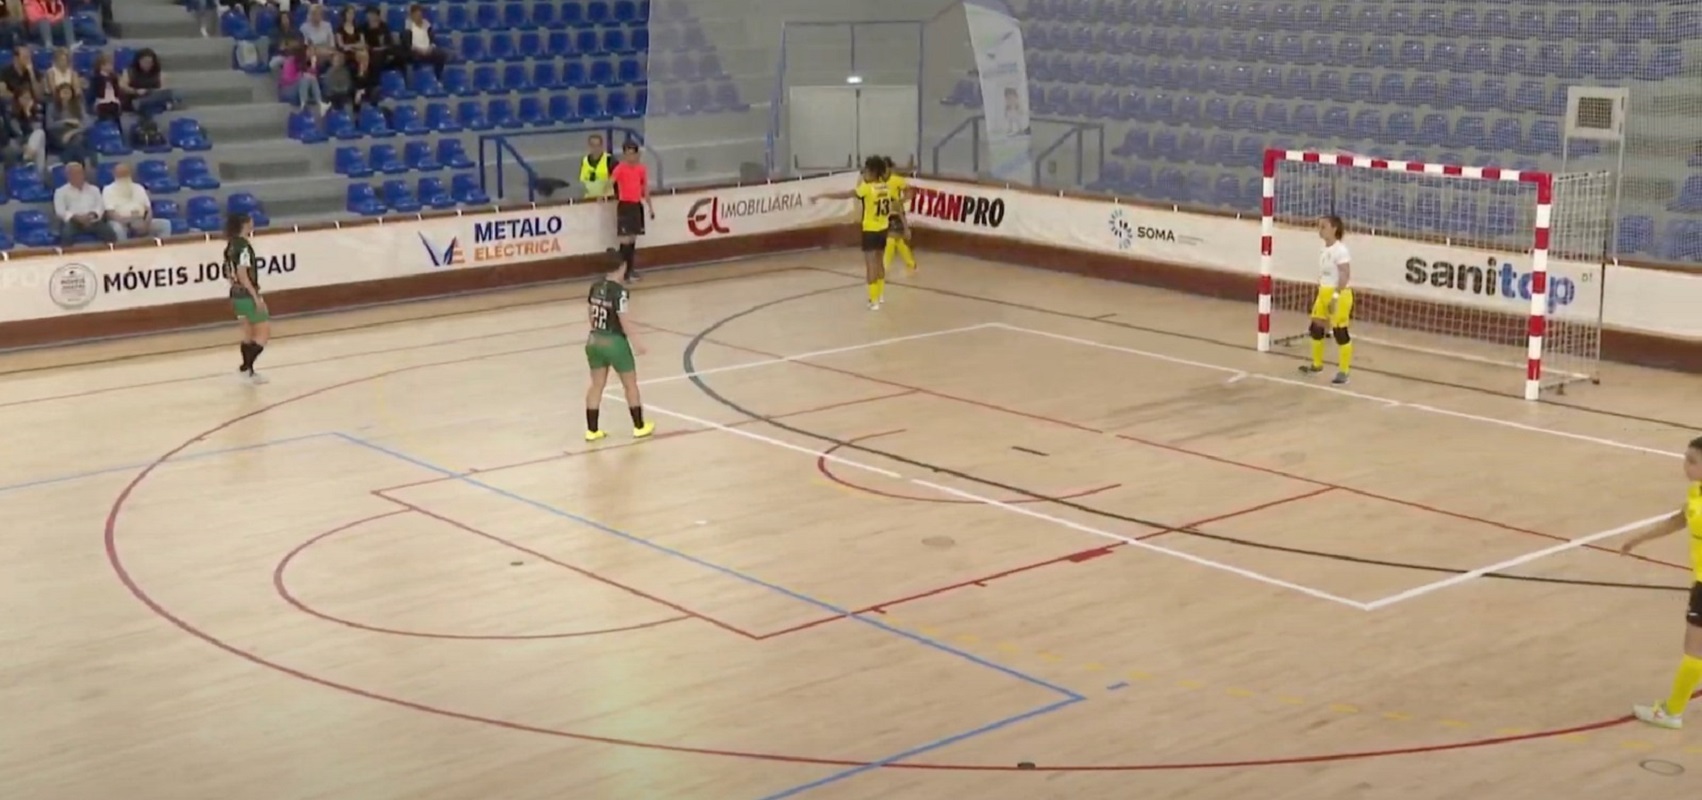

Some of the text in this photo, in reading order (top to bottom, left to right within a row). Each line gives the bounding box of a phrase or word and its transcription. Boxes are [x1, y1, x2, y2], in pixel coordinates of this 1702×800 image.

[874, 198, 890, 217] 13
[909, 186, 1005, 228] TITANPRO
[474, 215, 562, 243] METALO
[1137, 226, 1175, 242] SOMA
[103, 266, 188, 293] MÓVEIS
